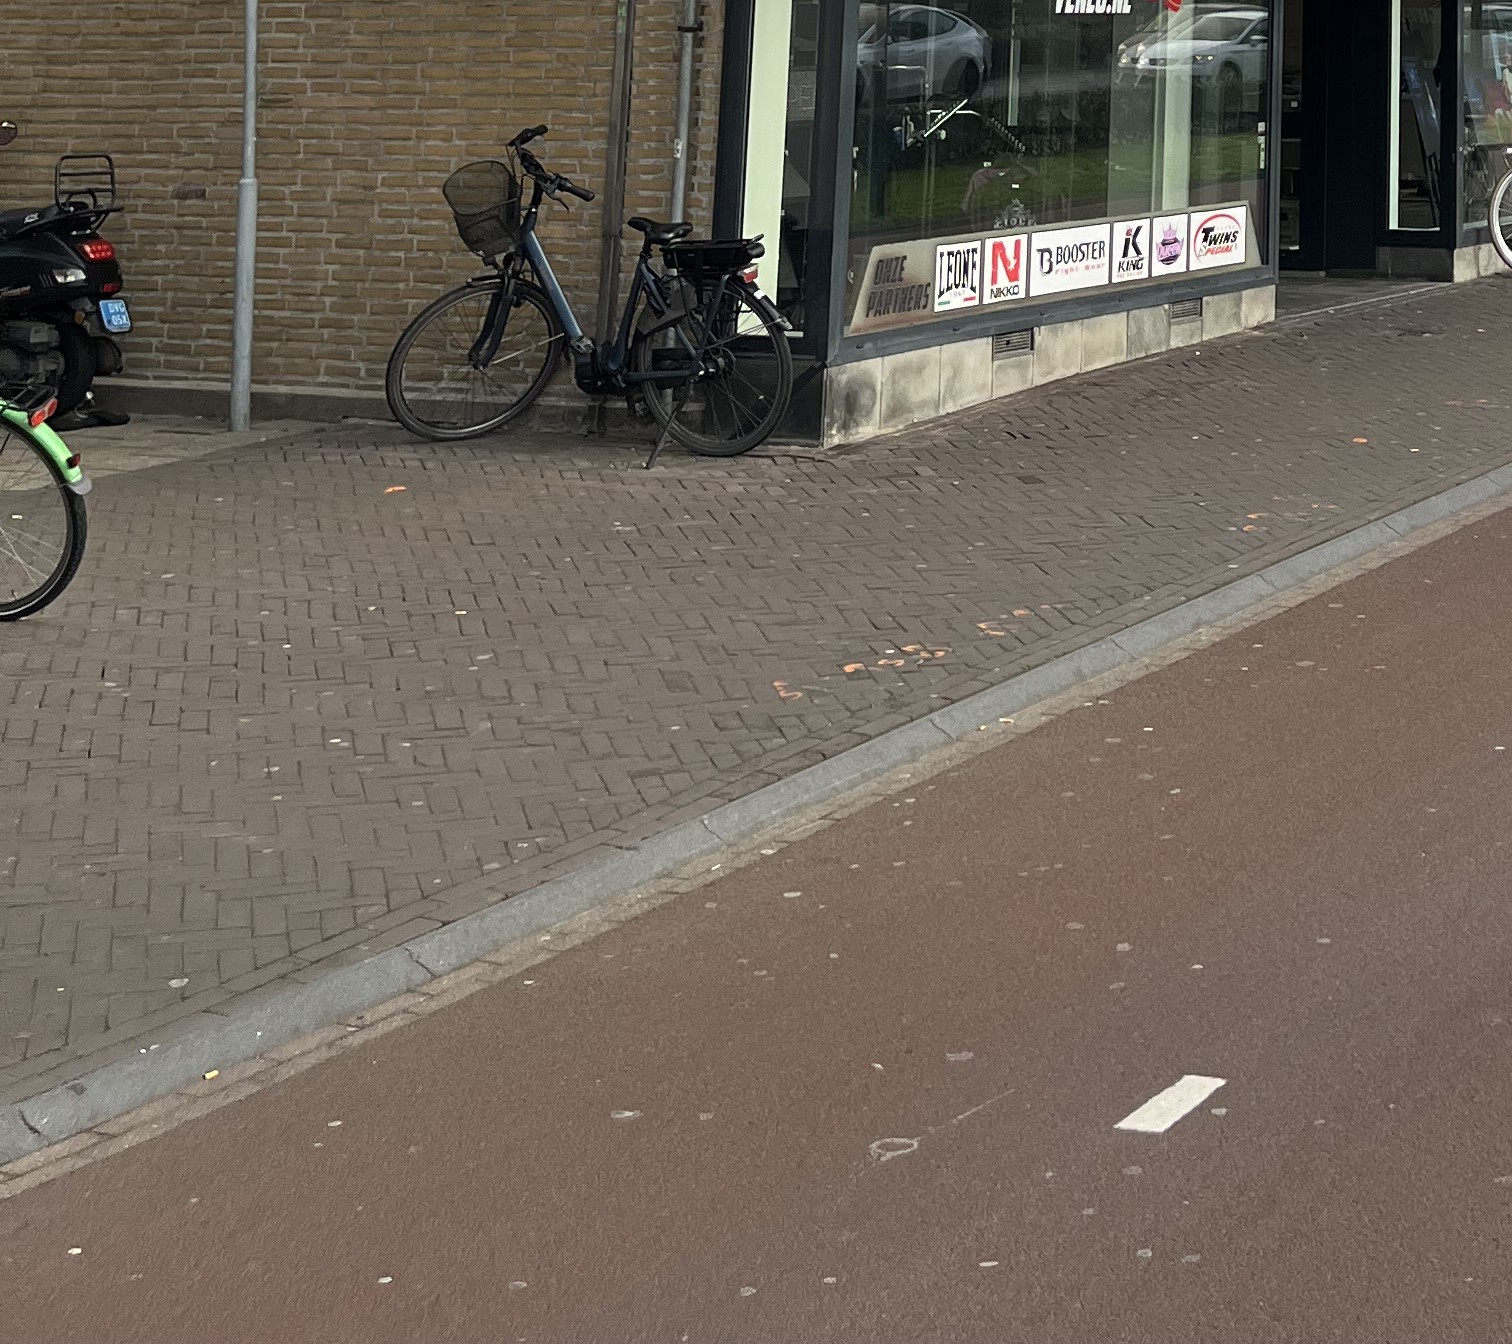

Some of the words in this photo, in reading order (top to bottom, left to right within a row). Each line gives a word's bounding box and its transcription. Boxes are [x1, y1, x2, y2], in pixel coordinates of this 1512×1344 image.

[1202, 225, 1240, 247] TWINS
[1056, 240, 1106, 266] BOOSTER
[1116, 256, 1145, 273] KING
[874, 255, 907, 286] ONZE
[937, 247, 978, 300] LEONE
[865, 282, 931, 318] PARTNERS
[990, 284, 1020, 299] NIKKO
